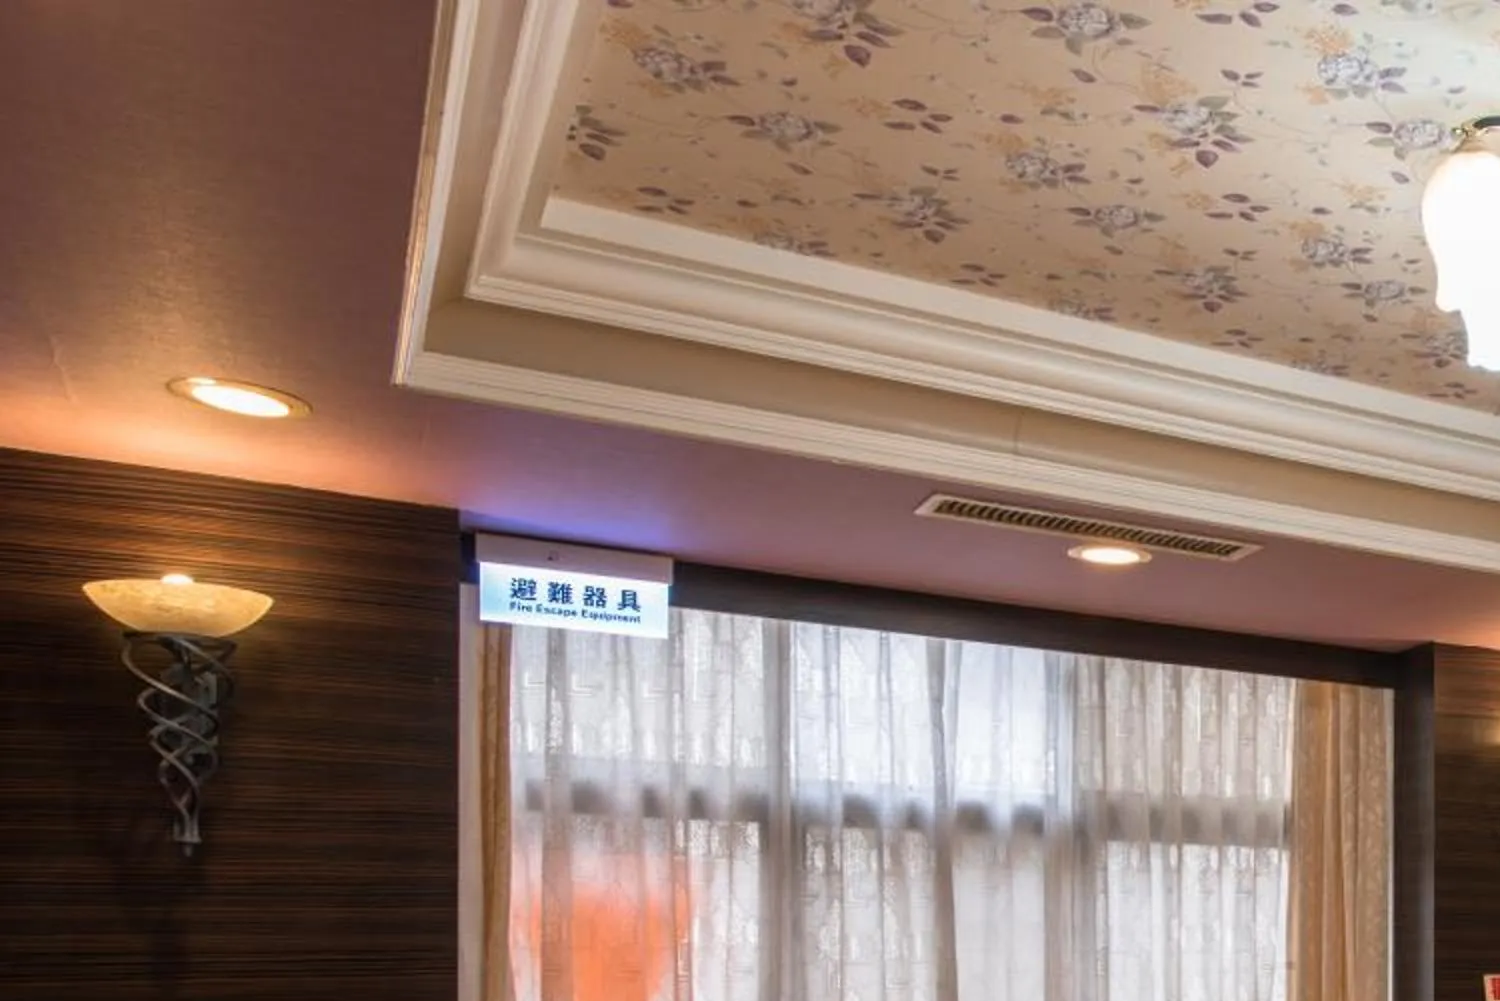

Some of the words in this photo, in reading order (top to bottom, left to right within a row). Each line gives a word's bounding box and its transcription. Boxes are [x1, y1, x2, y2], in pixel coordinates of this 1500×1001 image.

[510, 577, 641, 612] 避難器具
[509, 602, 532, 613] Fire
[536, 603, 577, 617] Escape
[581, 609, 641, 624] Equipment
